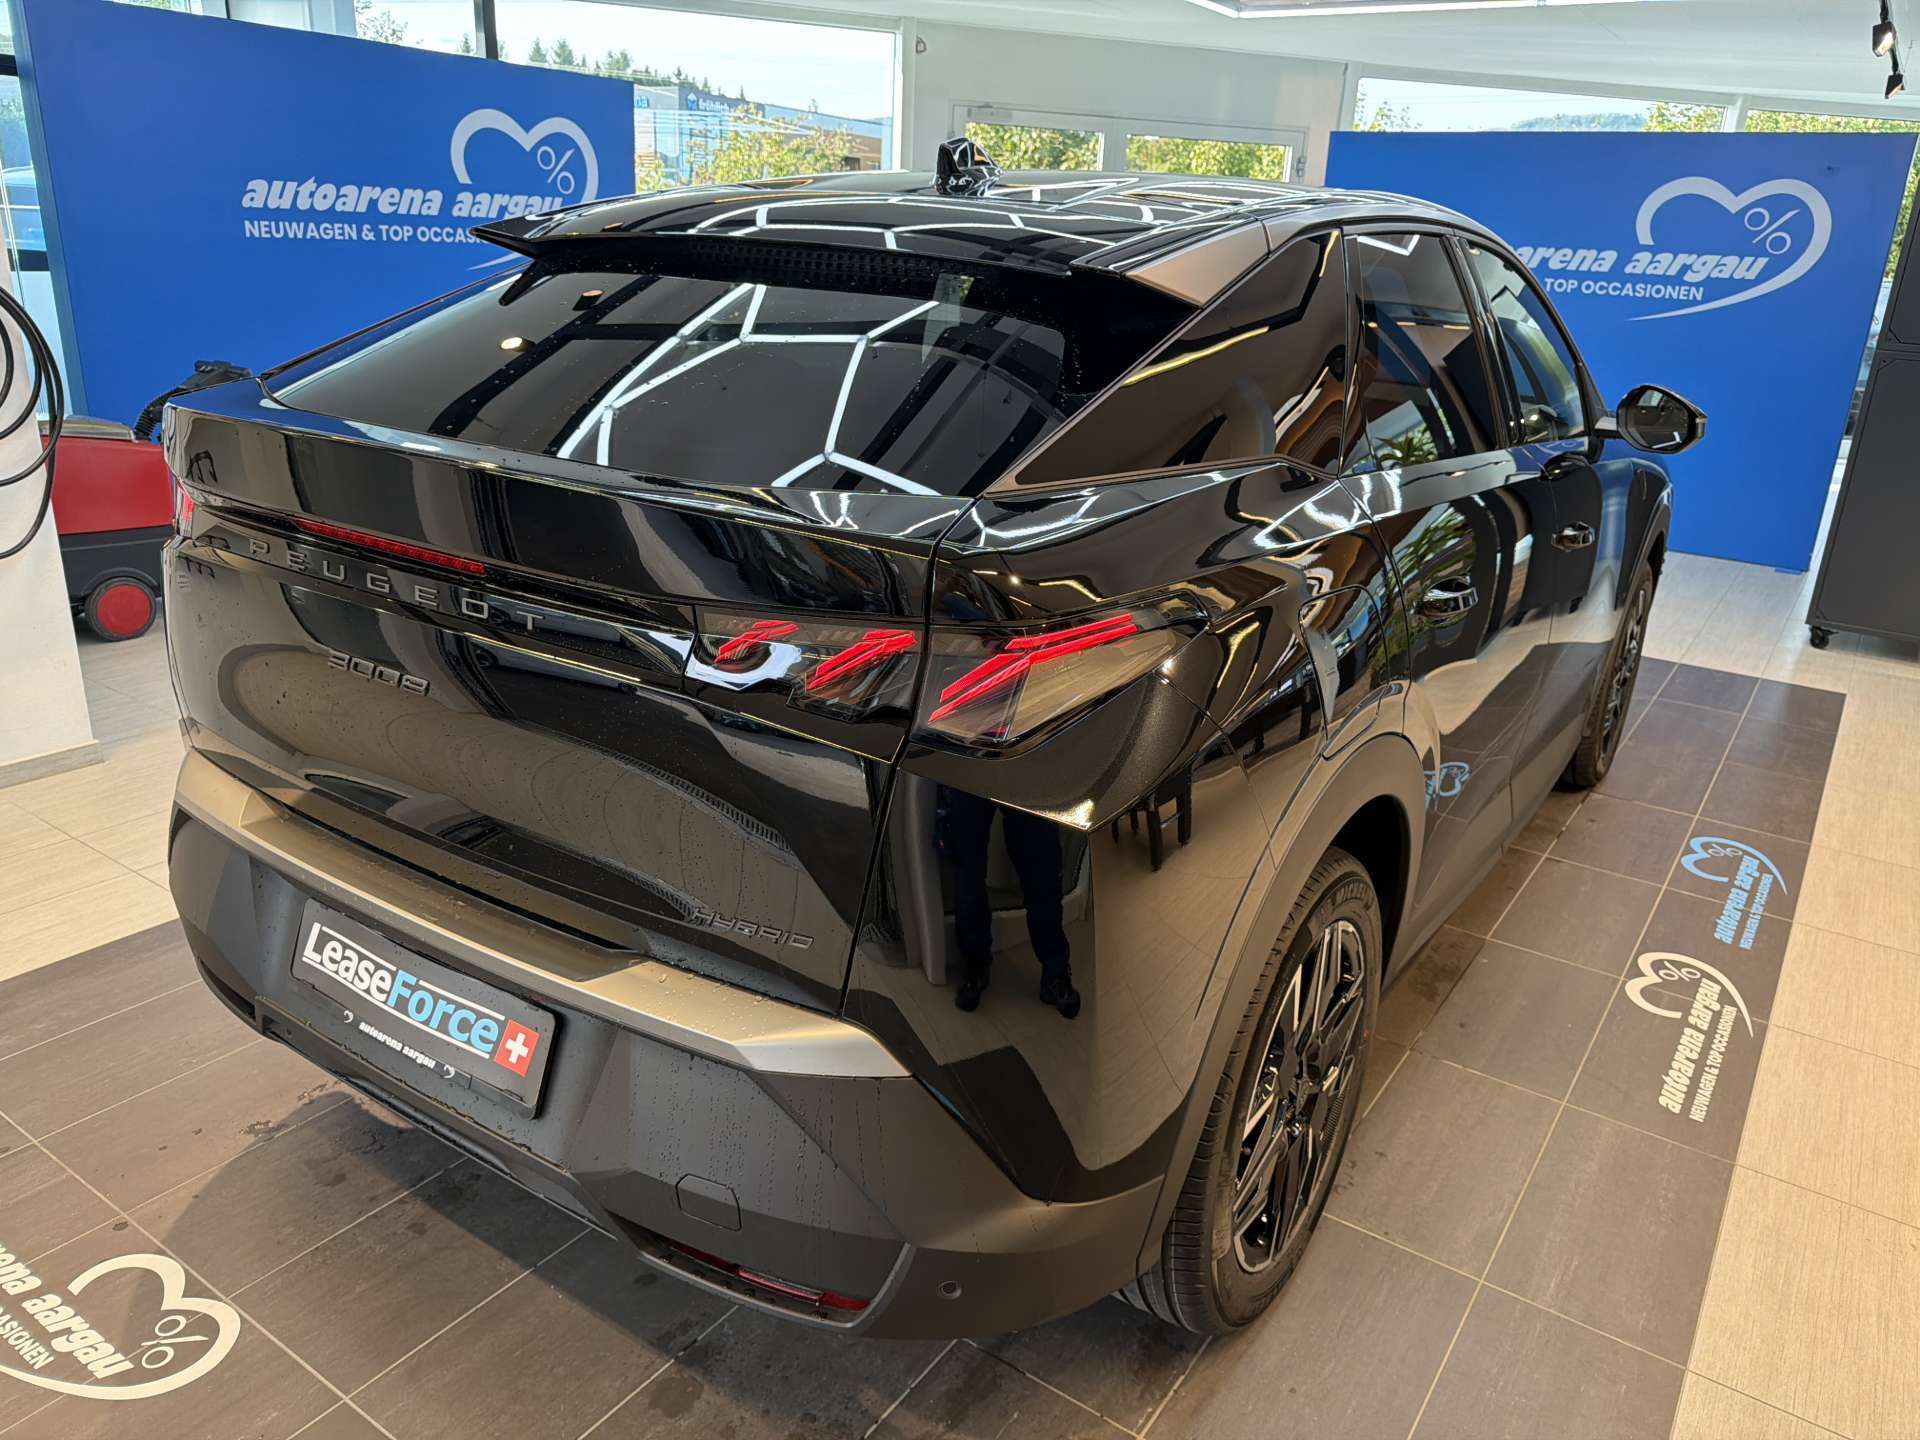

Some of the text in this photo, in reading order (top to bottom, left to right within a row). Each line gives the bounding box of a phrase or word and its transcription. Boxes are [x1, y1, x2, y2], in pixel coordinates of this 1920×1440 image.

[242, 176, 443, 217] autoarena
[244, 220, 485, 245] NEUWAGEN & TOP OCCAS
[1516, 246, 1770, 283] arena aargau
[1544, 277, 1704, 301] TOP OCCASIONEN
[250, 536, 545, 633] PEUGEOT
[327, 650, 430, 697] 3008
[691, 907, 815, 949] HYBRID
[1713, 855, 1761, 945] autoarena aargau
[302, 921, 500, 1054] LeaseForce
[358, 1021, 436, 1069] autoarena aargau
[1658, 978, 1722, 1114] autoarena aargau
[1688, 1005, 1738, 1122] NEUWAGEN & TOP OCCASIONEN
[0, 1305, 55, 1371] ASIONEN
[21, 1294, 135, 1379] aargau
